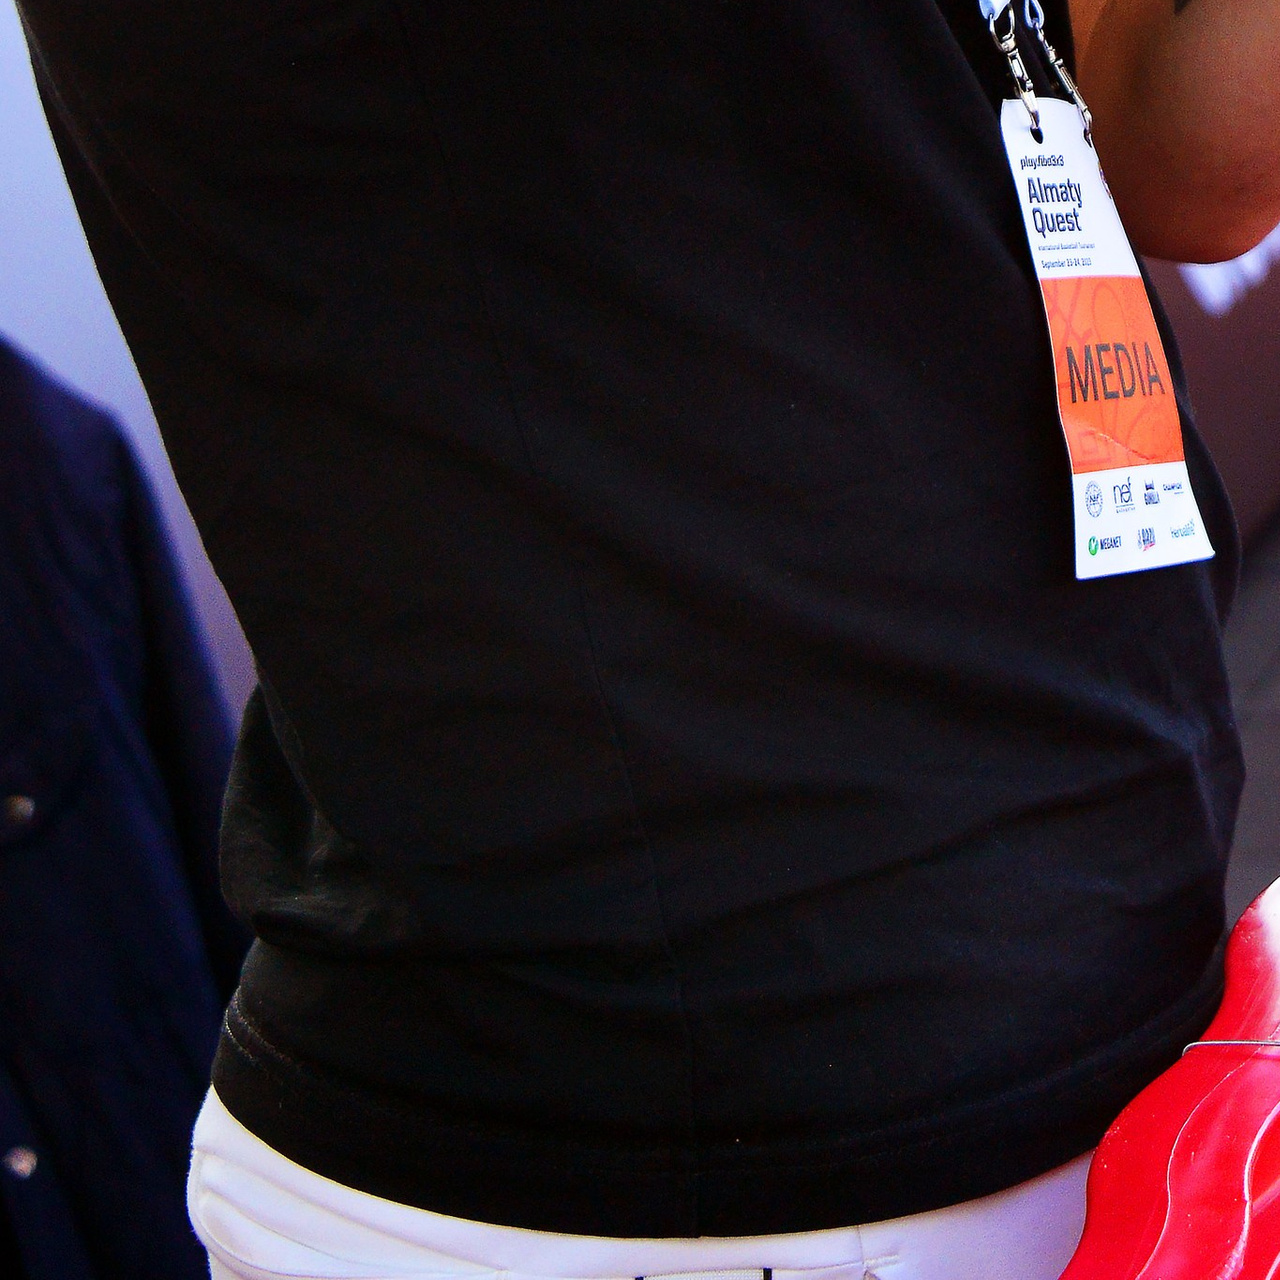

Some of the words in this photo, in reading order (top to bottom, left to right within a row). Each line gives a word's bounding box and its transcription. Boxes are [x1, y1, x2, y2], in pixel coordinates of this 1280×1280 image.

[1027, 177, 1082, 208] Almaty
[1032, 207, 1082, 238] Quest
[1066, 342, 1165, 403] MEDIA
